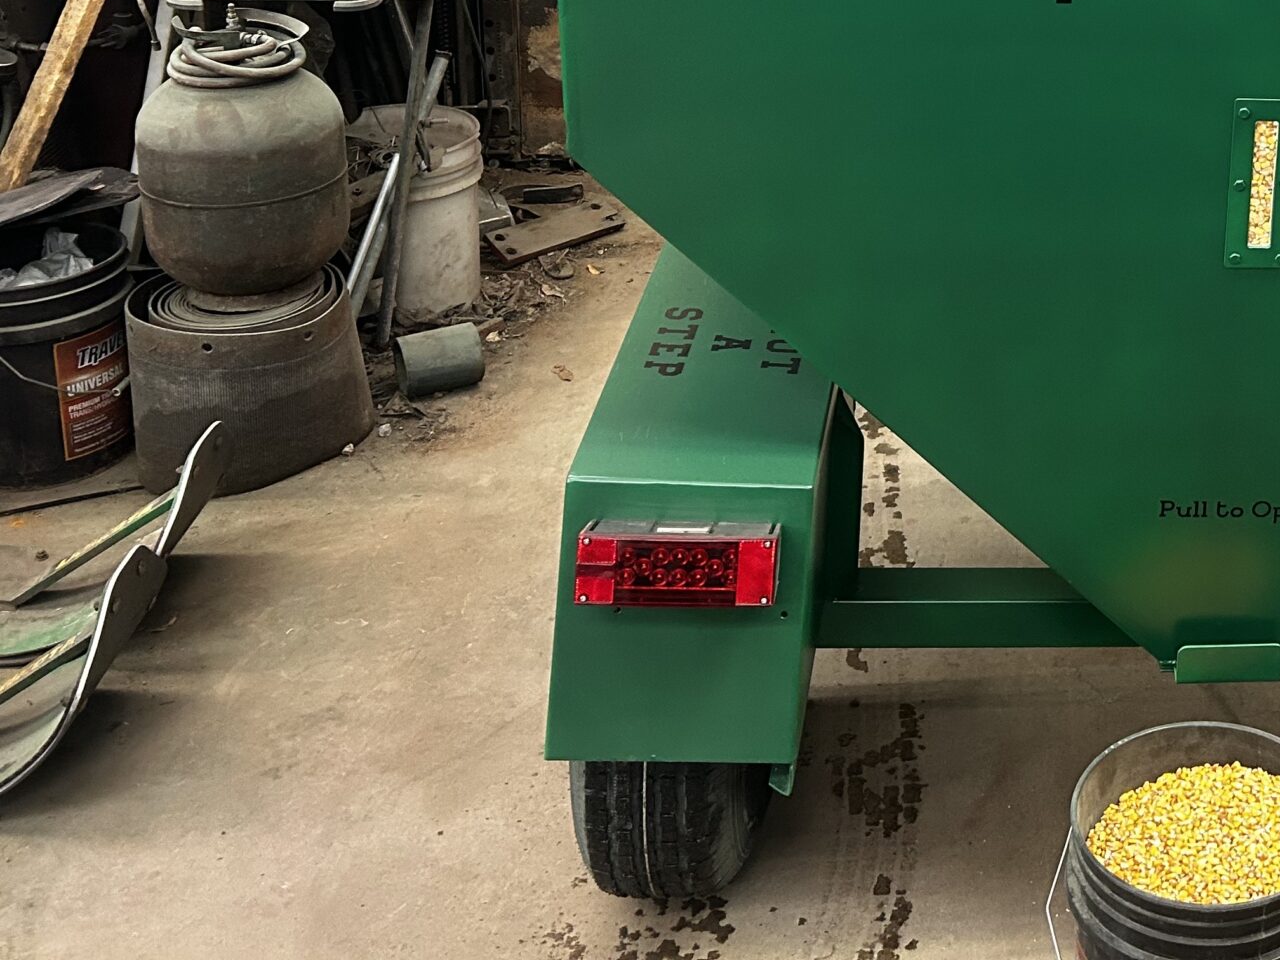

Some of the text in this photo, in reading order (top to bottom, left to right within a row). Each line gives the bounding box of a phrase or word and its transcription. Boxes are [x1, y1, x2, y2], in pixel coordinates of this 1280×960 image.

[643, 307, 704, 377] STEP
[711, 334, 752, 352] A
[67, 363, 123, 397] UNIVERSAL
[1159, 500, 1208, 518] Pull
[1216, 501, 1244, 518] to
